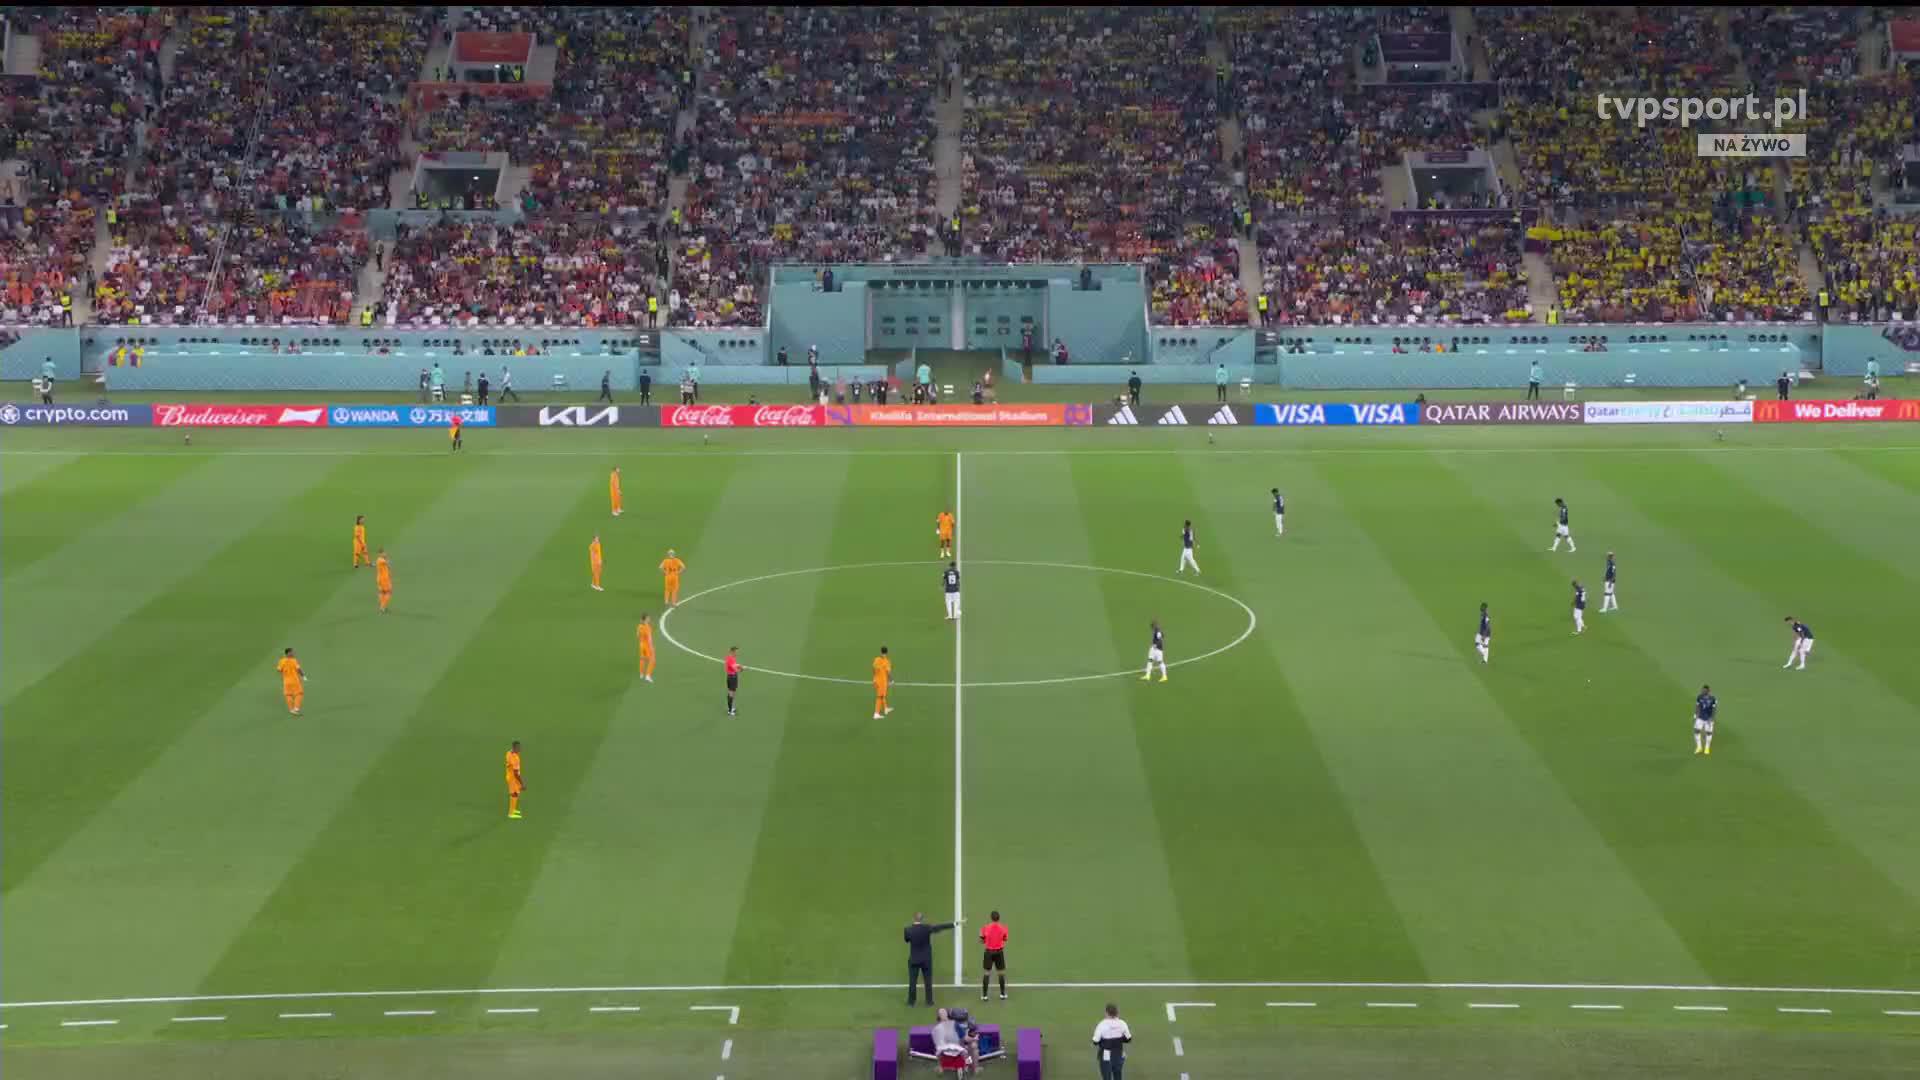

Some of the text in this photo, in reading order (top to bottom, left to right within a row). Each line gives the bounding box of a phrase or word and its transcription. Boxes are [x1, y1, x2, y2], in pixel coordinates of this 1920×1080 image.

[26, 407, 128, 422] crypto.com
[156, 405, 267, 425] Budweiser
[350, 410, 398, 422] WANDA
[1270, 405, 1325, 423] VISA
[1350, 405, 1405, 423] VISA
[1425, 405, 1579, 423] QATAR AIRWAYS
[1795, 403, 1883, 417] We Deliver
